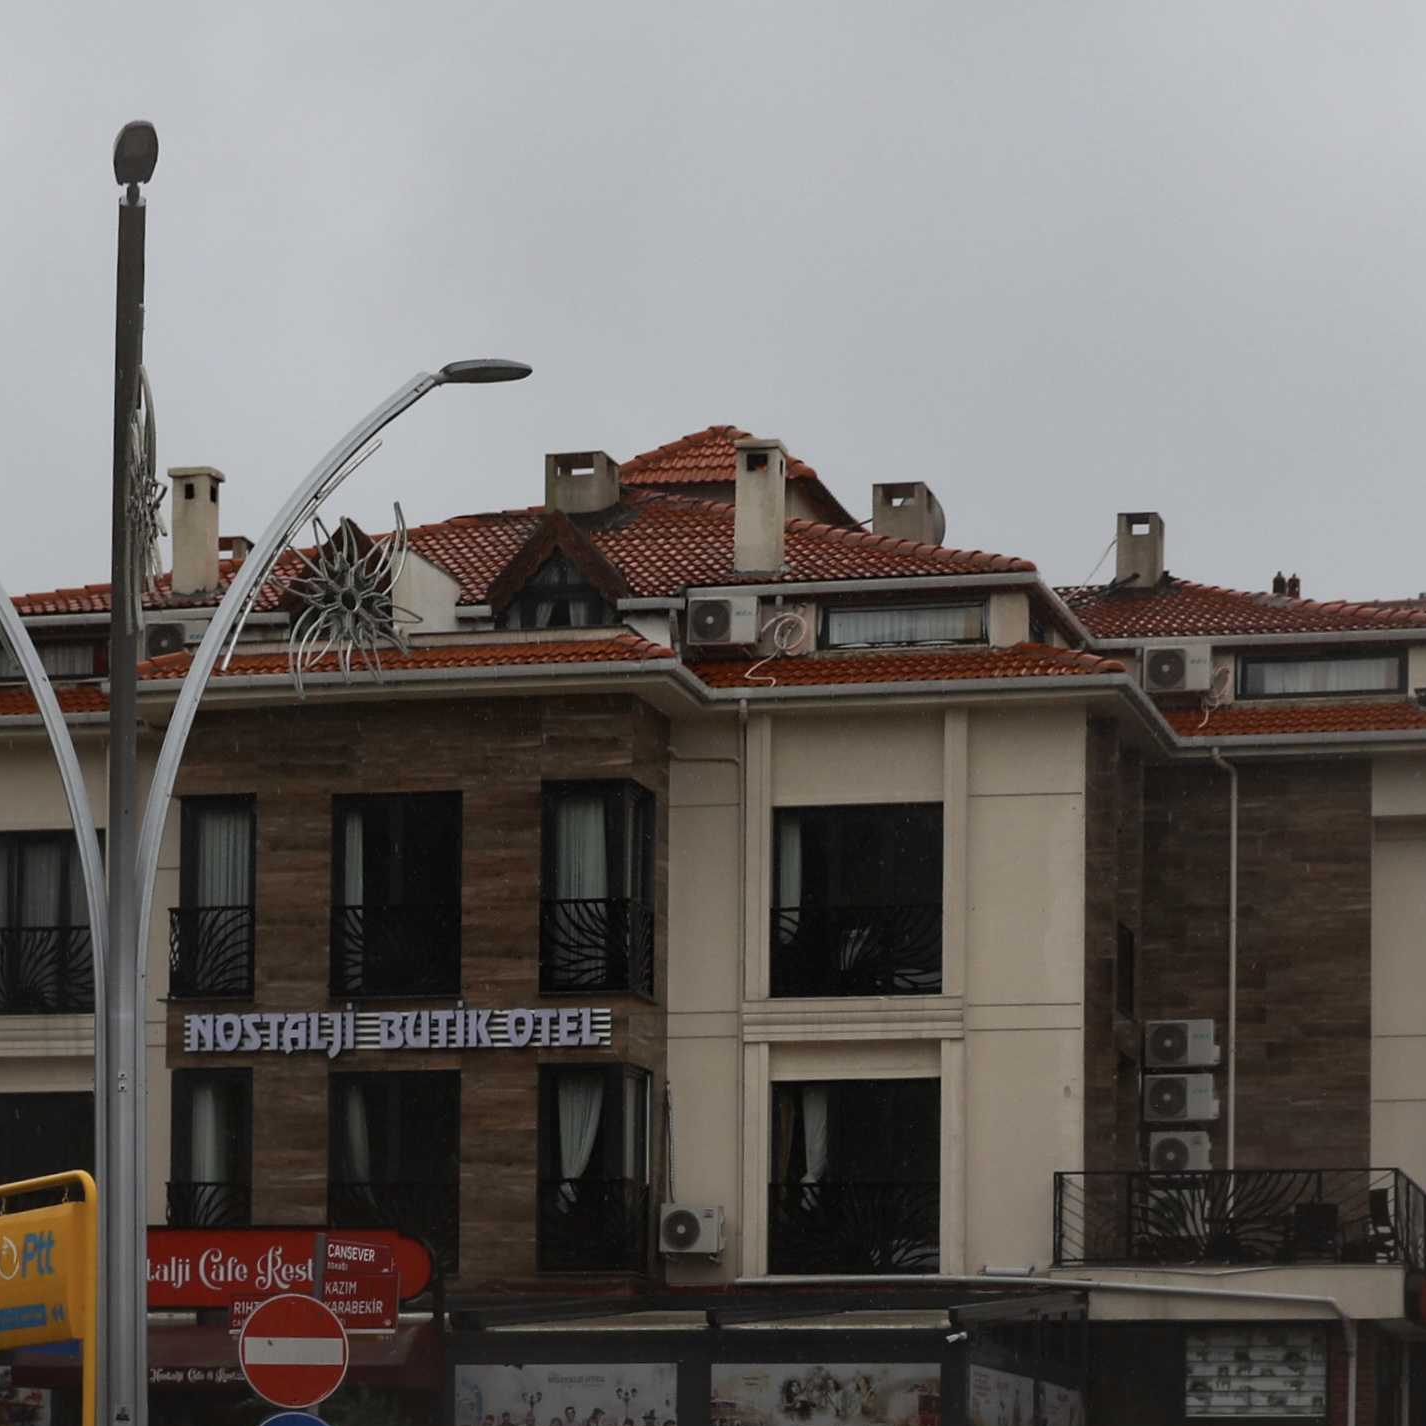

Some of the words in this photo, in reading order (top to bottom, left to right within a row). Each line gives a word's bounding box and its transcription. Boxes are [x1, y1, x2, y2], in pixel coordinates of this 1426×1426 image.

[188, 1001, 355, 1059] NOSTALJİ
[378, 1001, 492, 1050] BUTİK
[506, 1007, 603, 1047] OTEL
[22, 1231, 55, 1279] Ptt
[198, 1248, 249, 1290] Cafe
[327, 1243, 375, 1262] CANSEVER
[325, 1281, 357, 1295] KAZIM
